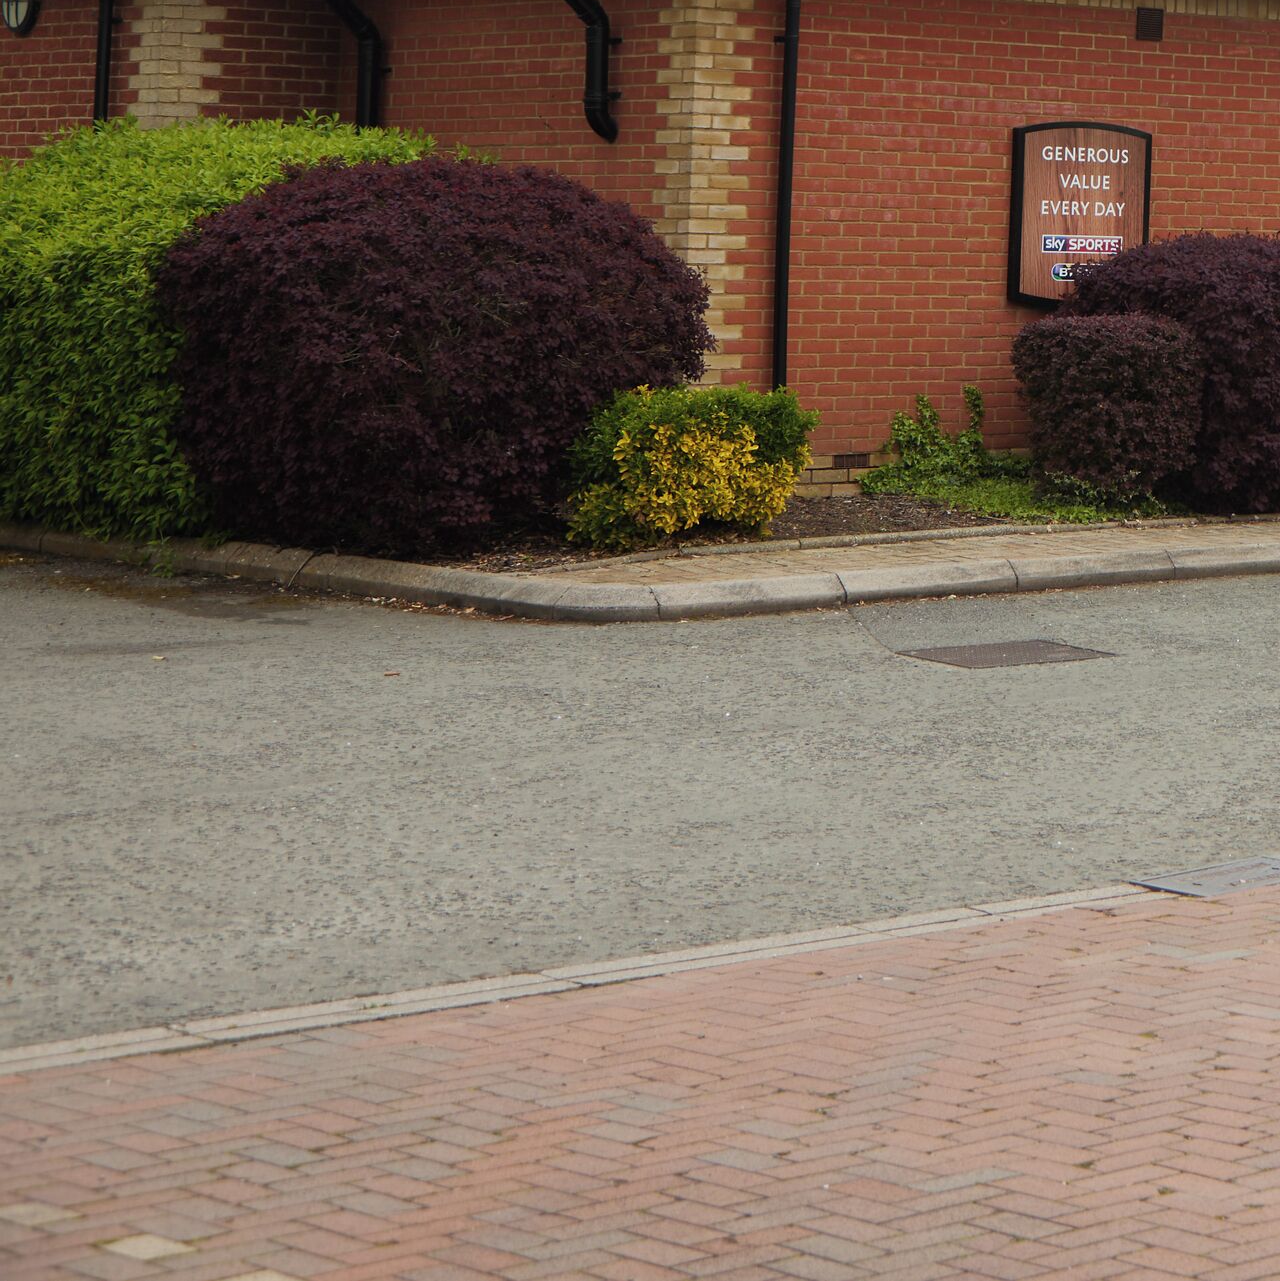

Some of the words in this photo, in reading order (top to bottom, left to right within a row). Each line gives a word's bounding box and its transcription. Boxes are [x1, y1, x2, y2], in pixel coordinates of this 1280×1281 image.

[1042, 145, 1129, 163] GENEROUS
[1060, 173, 1110, 190] VALUE
[1041, 200, 1090, 216] EVERY
[1094, 202, 1126, 217] DAY
[1045, 236, 1066, 251] sky
[1068, 238, 1119, 251] SPORTS
